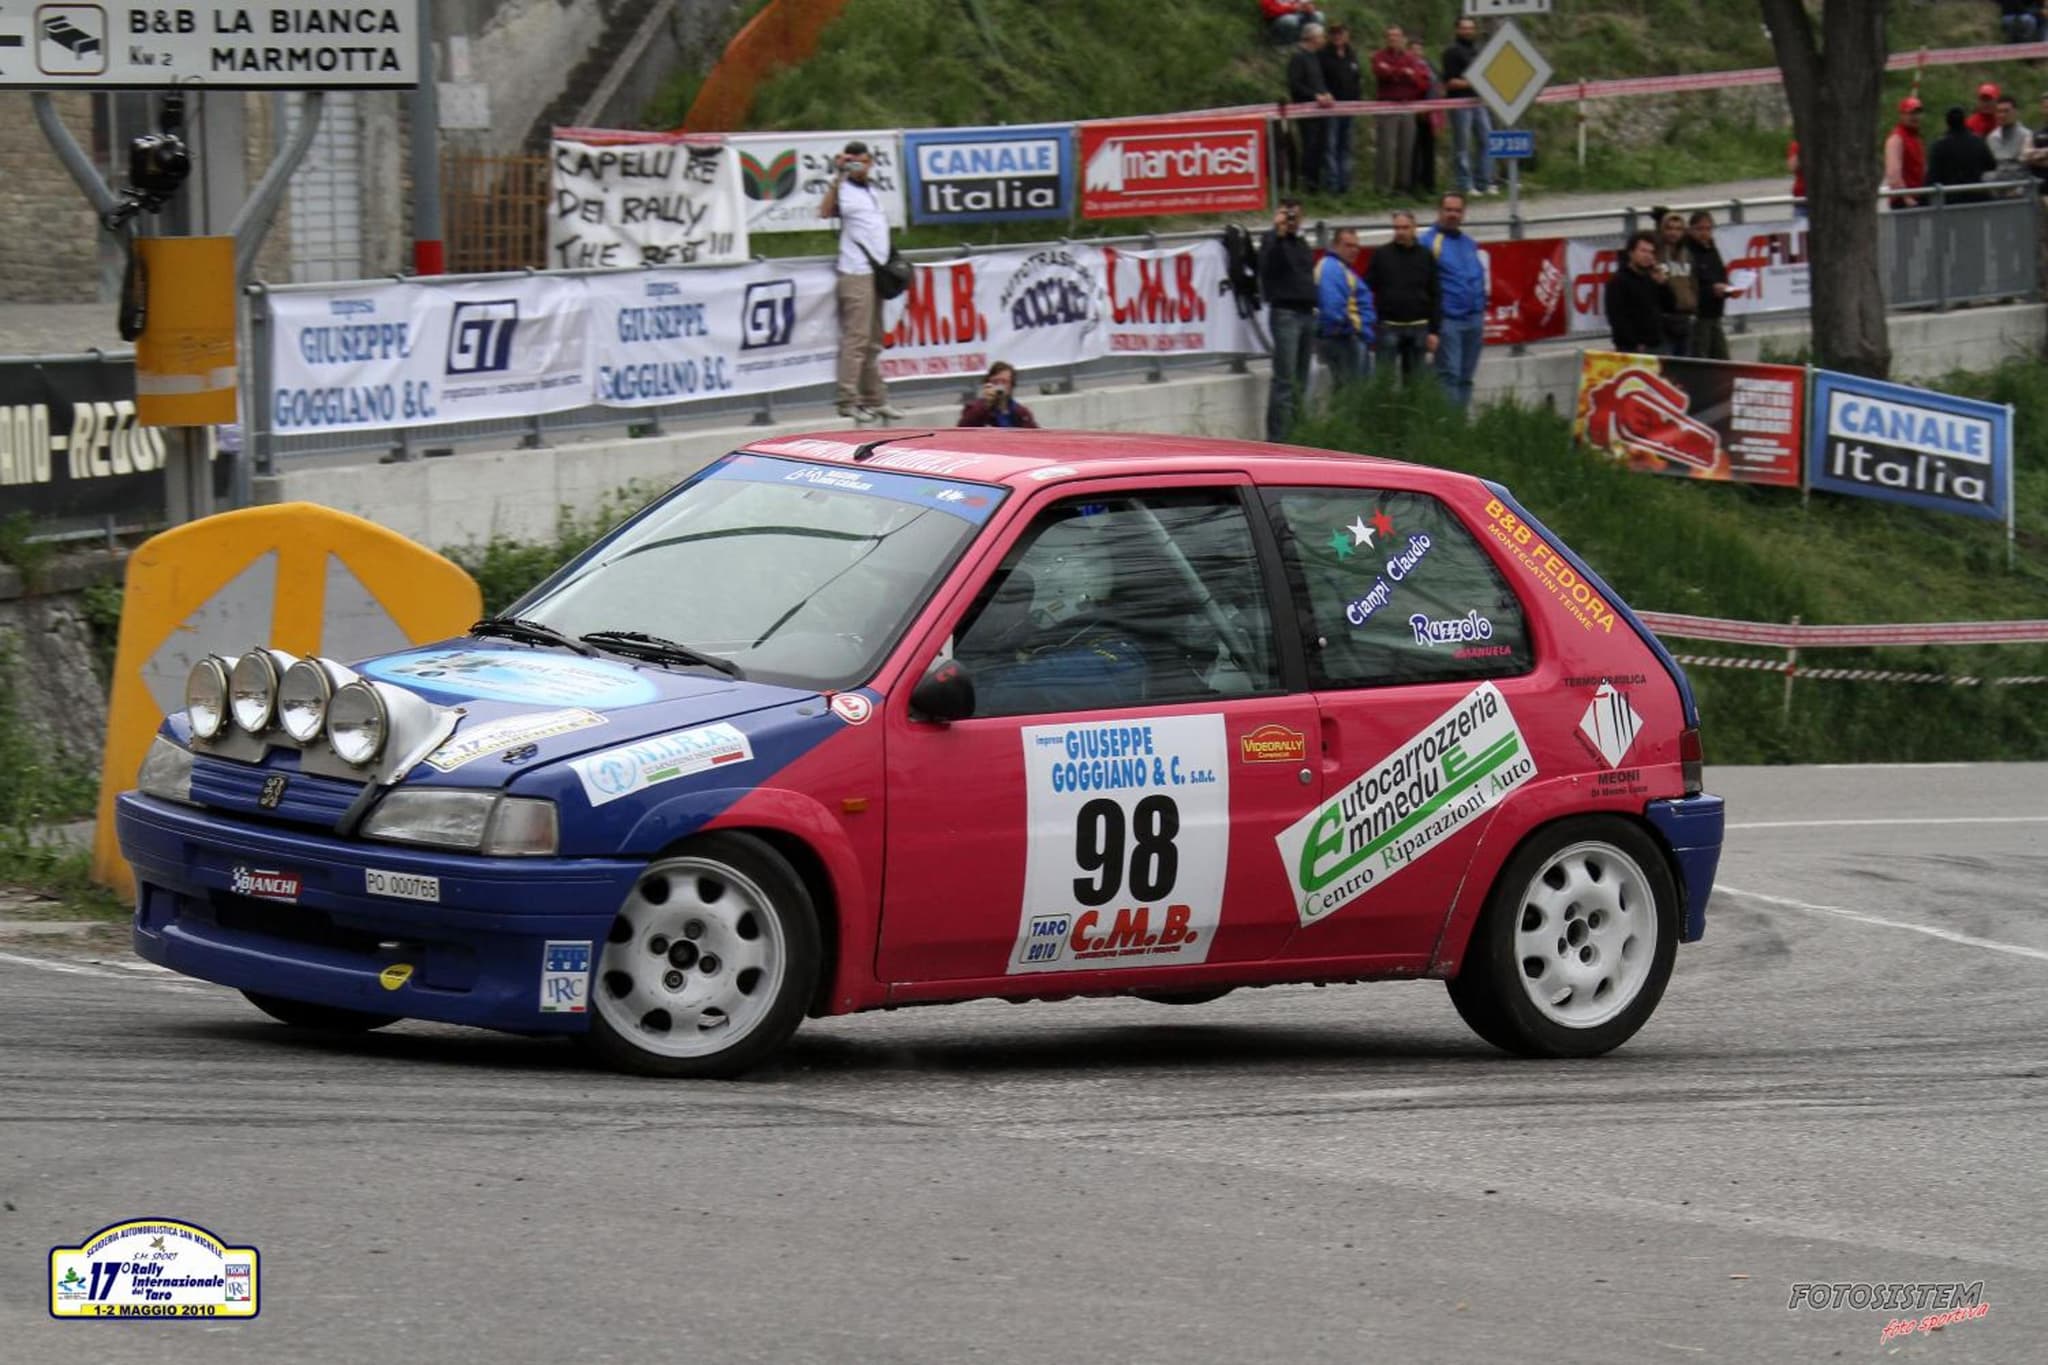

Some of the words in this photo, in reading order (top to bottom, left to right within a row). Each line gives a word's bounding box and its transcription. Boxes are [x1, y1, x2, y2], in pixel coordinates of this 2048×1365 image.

[129, 9, 196, 33] B&B
[213, 9, 253, 33] LA
[270, 9, 401, 33] BIANCA
[160, 52, 173, 66] 2
[211, 47, 401, 71] MARMOTTA
[927, 145, 1052, 175] CANALE
[1123, 139, 1257, 179] marchesi
[928, 180, 1055, 212] Italia
[621, 195, 708, 237] RALLY
[555, 235, 622, 269] THE
[619, 303, 709, 342] GIUSEPPE
[300, 322, 411, 364] GIUSEPPE
[274, 384, 395, 427] GOGGIANO
[1838, 400, 1985, 457] CANALE
[1832, 442, 1986, 502] Italia
[1346, 575, 1391, 625] Ciampi
[1386, 533, 1431, 581] Claudio
[1485, 499, 1532, 545] B&B
[1531, 543, 1615, 633] FEDORA
[1488, 523, 1558, 594] MONTECATINI
[1558, 592, 1594, 632] TERME
[1409, 608, 1493, 647] Ruzzolo
[1065, 726, 1154, 760] GIUSEPPE
[1052, 758, 1147, 792] GOGGIANO
[1152, 756, 1166, 786] &
[1171, 755, 1186, 785] C.
[1598, 769, 1640, 785] MEONI
[1072, 794, 1180, 907] 98
[1302, 869, 1375, 918] Centro
[1380, 783, 1487, 870] Riparazioni
[1489, 756, 1532, 797] Auto
[240, 875, 298, 895] BIANCHI
[367, 872, 385, 891] PO
[390, 876, 438, 899] 000765
[1031, 919, 1067, 937] TARO
[1069, 904, 1198, 952] C.M.B.
[1027, 942, 1057, 960] 2010
